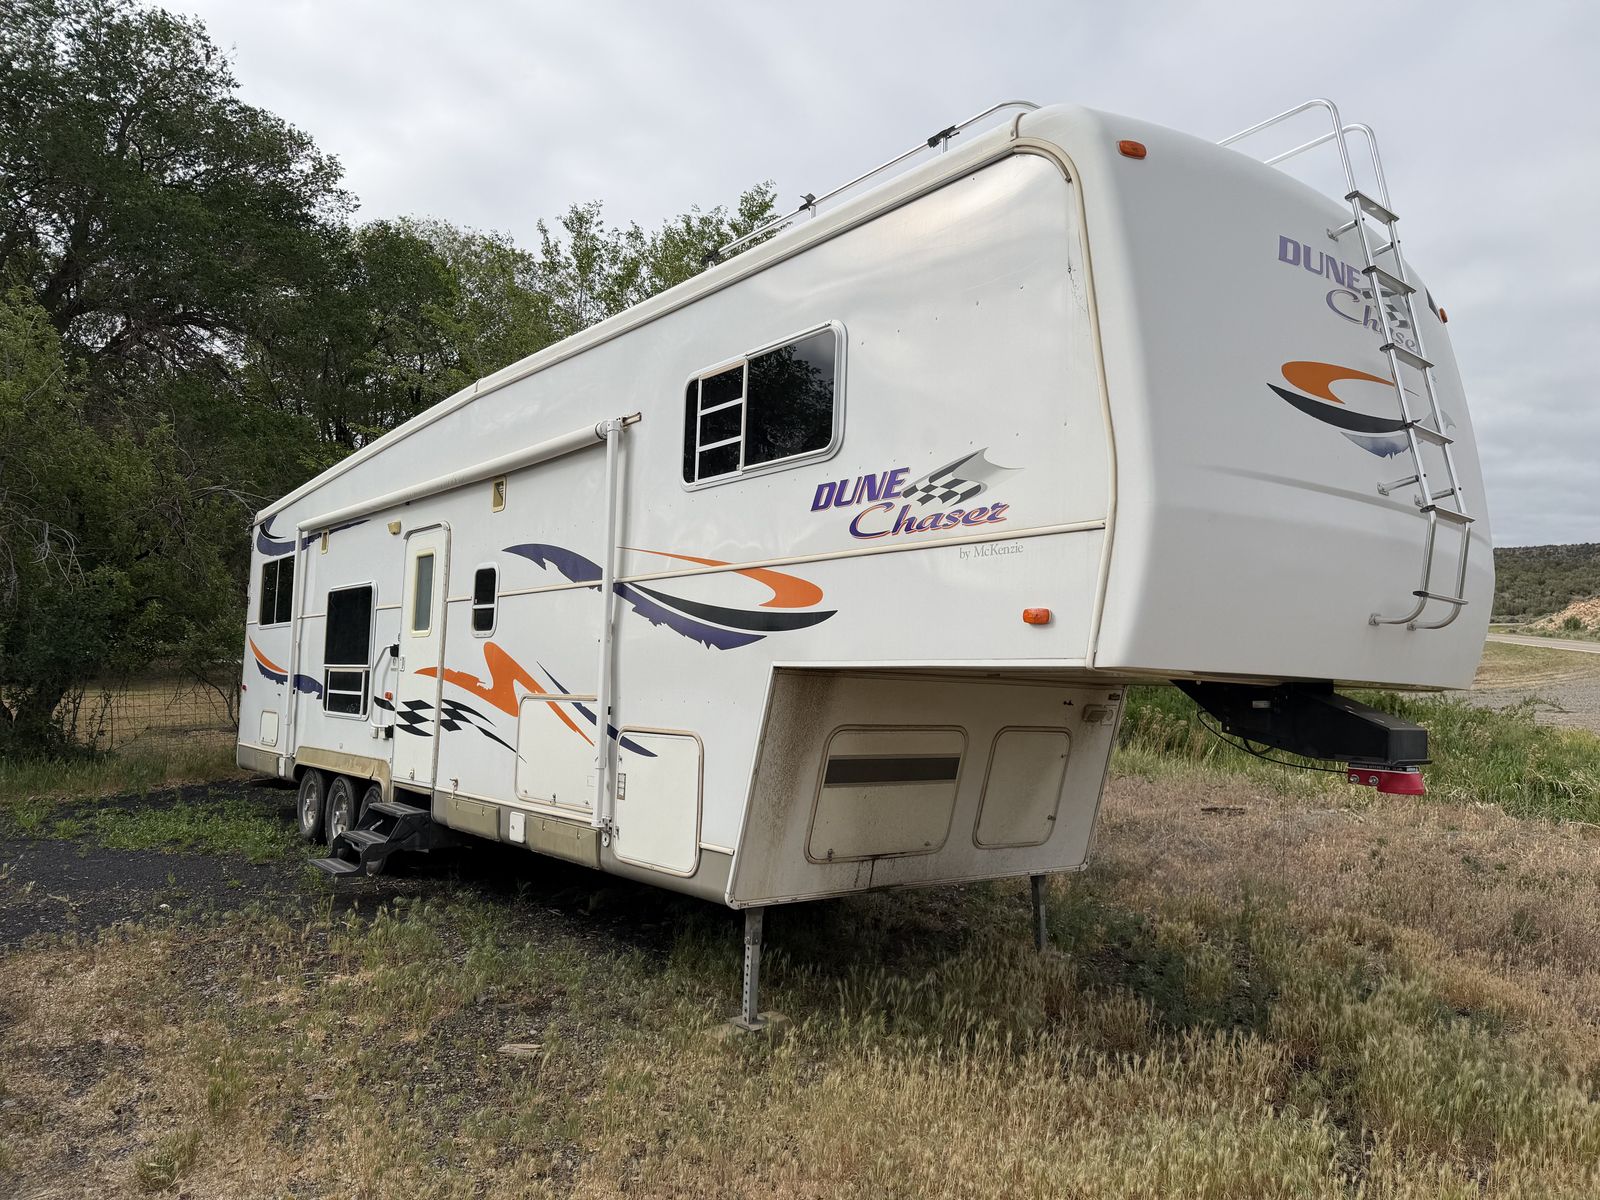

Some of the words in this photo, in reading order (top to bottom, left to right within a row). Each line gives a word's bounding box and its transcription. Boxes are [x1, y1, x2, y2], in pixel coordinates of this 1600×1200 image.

[1279, 235, 1361, 293] DUNE
[1326, 289, 1420, 353] Chse
[811, 467, 911, 512] DUNE
[849, 502, 1010, 539] Chaser
[959, 547, 971, 560] by
[974, 542, 1024, 558] McKenzie
